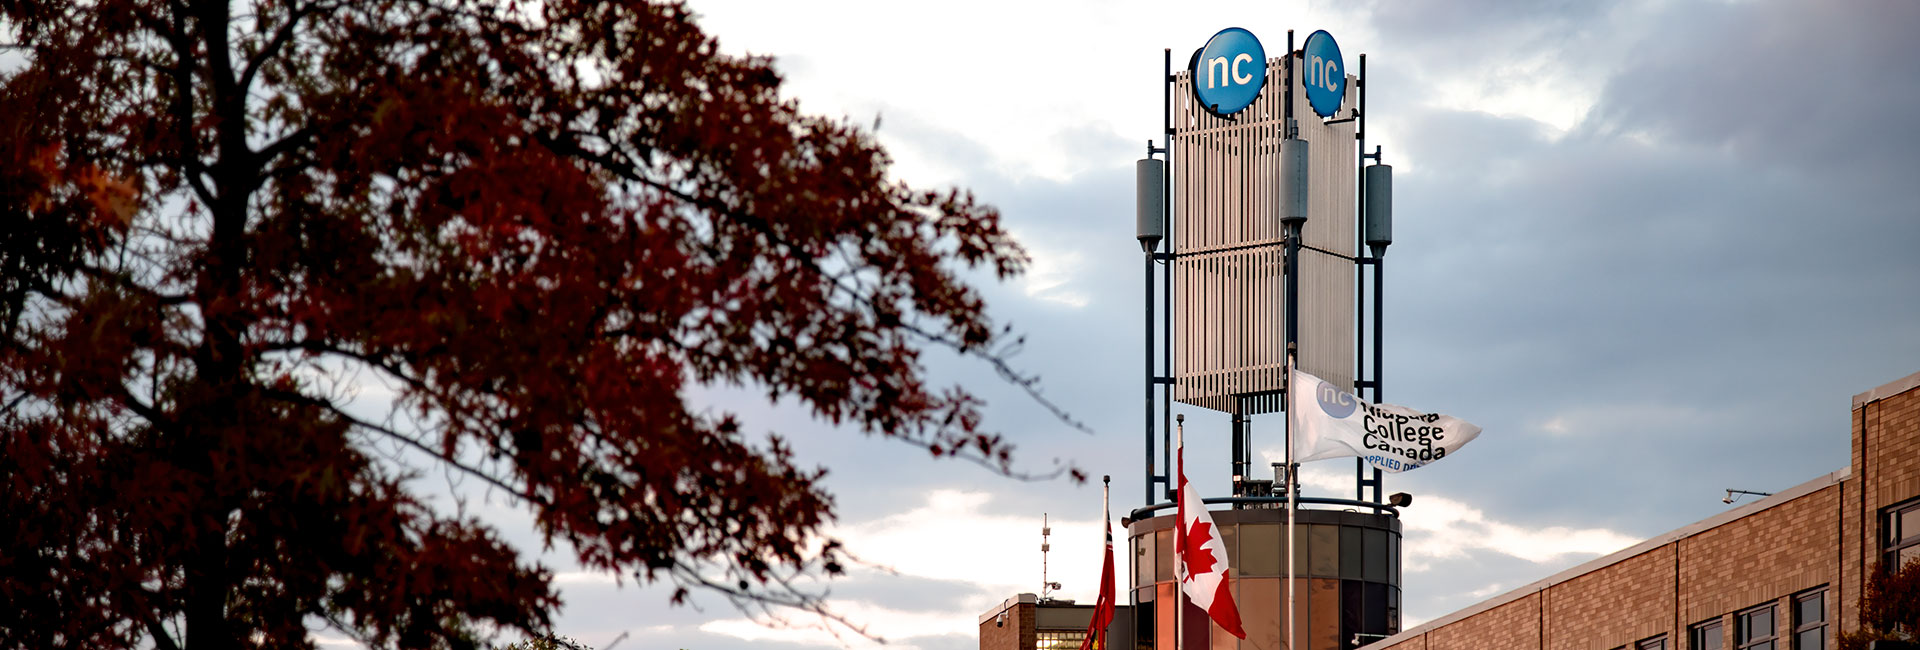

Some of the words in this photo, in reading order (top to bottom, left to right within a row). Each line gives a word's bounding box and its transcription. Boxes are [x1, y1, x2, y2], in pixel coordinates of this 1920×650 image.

[1208, 53, 1253, 89] nc
[1310, 54, 1338, 92] nc
[1323, 387, 1351, 407] nc
[1363, 415, 1444, 446] College
[1363, 433, 1446, 461] Canada
